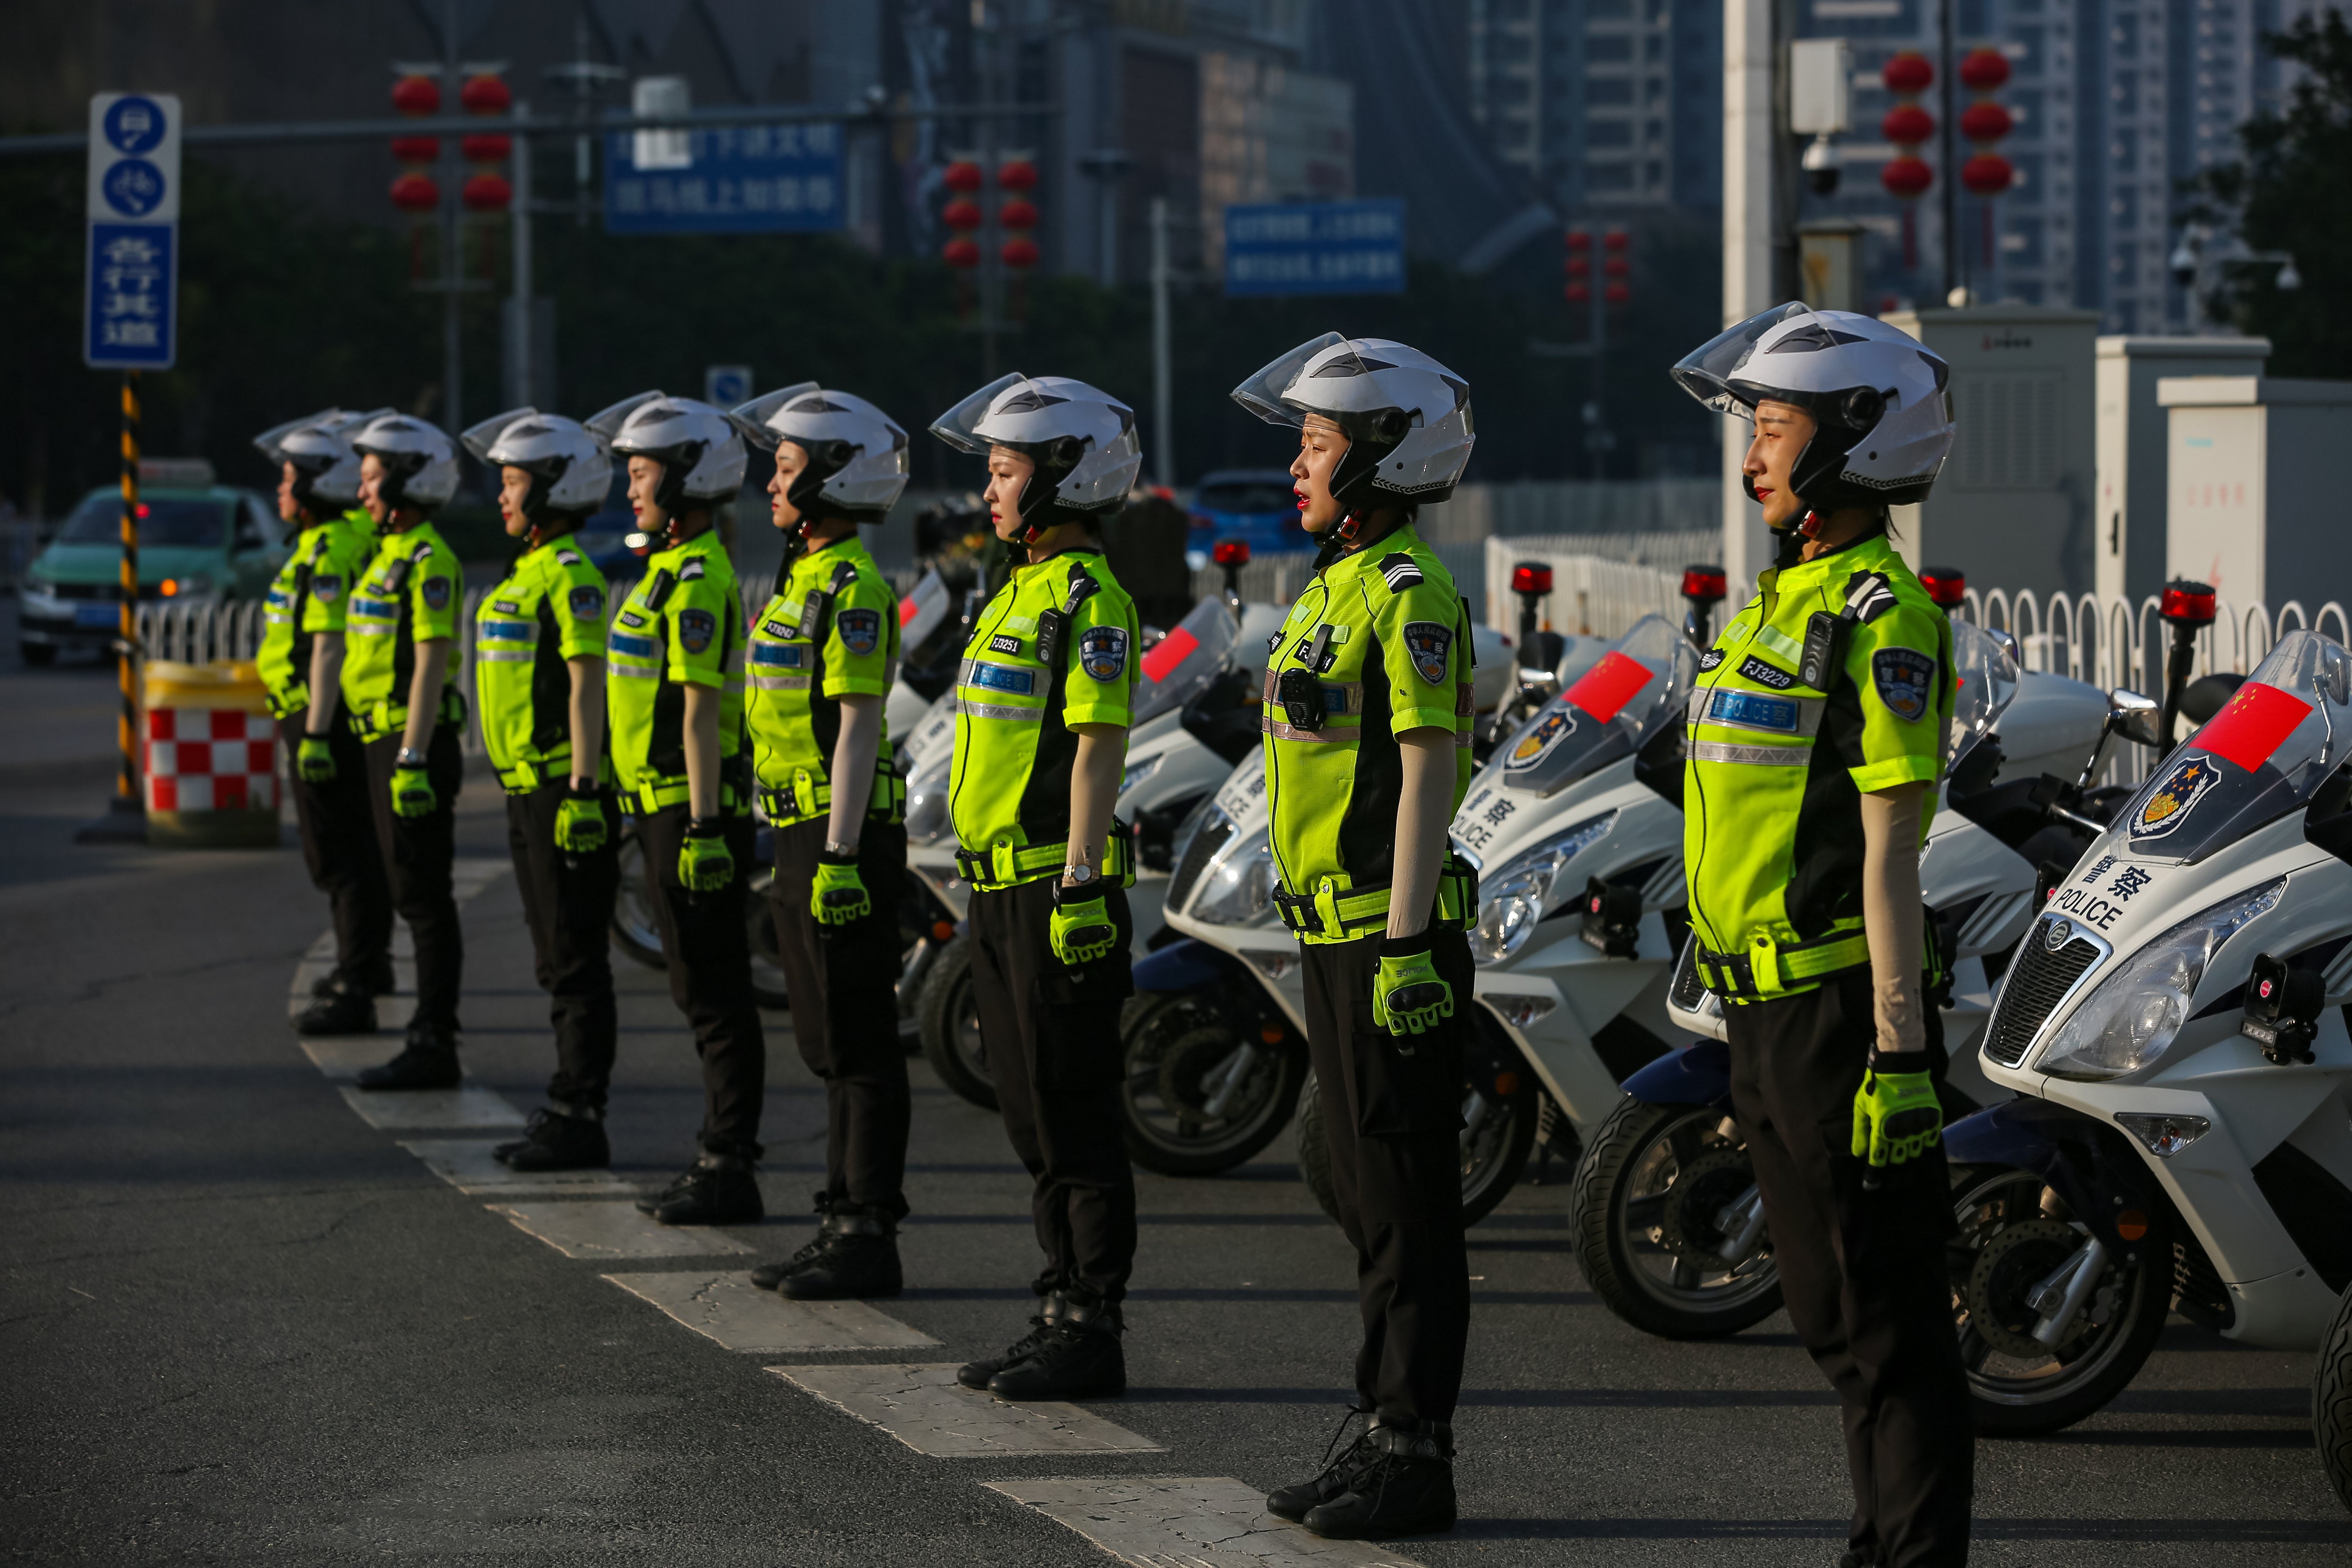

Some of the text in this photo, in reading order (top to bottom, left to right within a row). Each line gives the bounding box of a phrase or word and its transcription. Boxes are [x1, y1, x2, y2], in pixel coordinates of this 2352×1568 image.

[102, 237, 162, 348] 各行其道
[991, 637, 1019, 653] FJ3251
[1743, 660, 1791, 687] FJ3229
[2053, 888, 2124, 931] POLICE
[1396, 963, 1428, 978] POLICE
